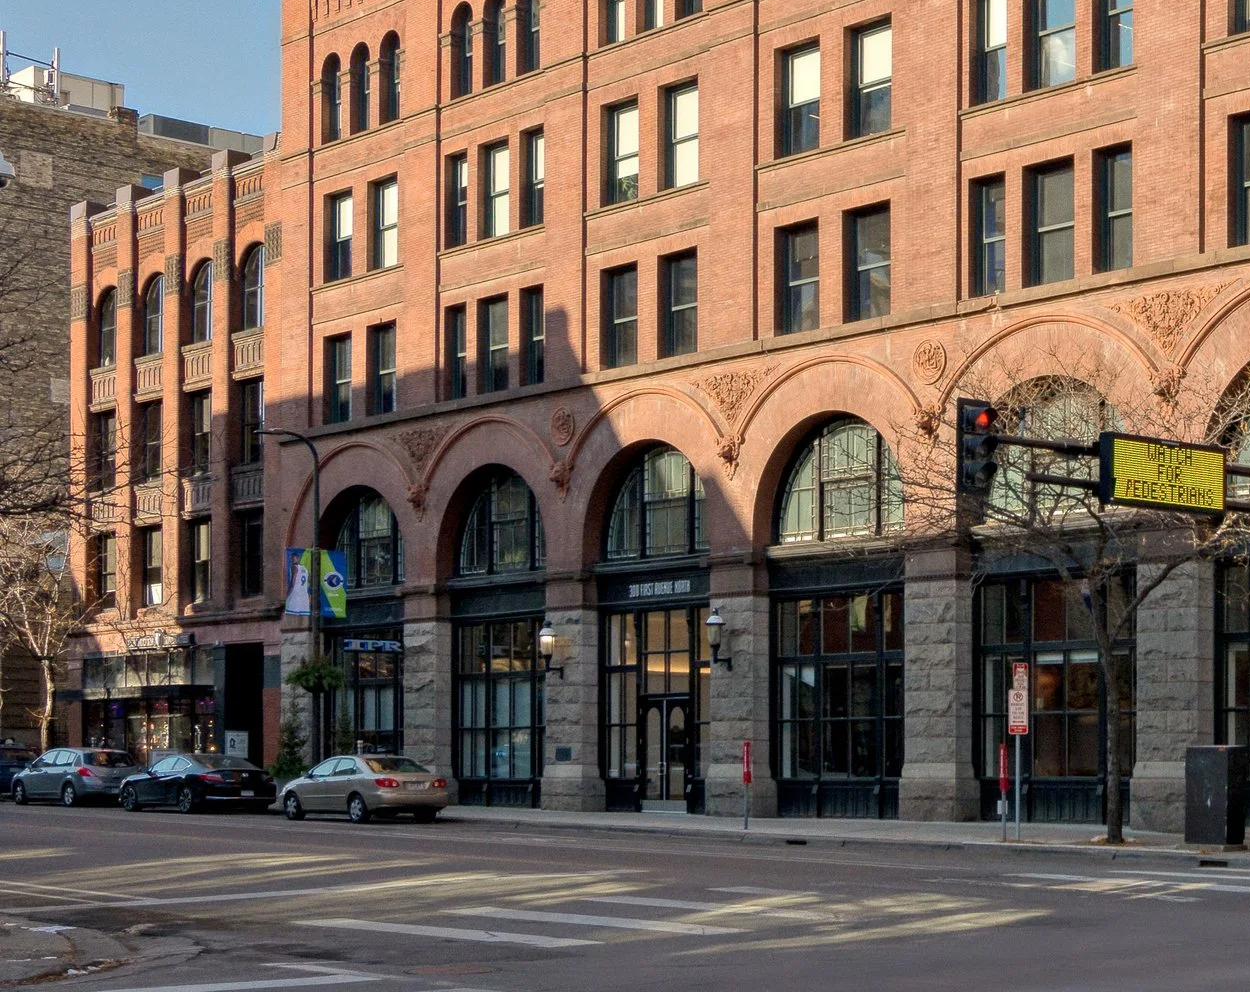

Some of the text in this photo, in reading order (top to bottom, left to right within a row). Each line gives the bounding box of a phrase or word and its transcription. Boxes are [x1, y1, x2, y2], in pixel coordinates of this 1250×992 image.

[1148, 443, 1193, 466] WATCH
[1158, 464, 1182, 484] FOR
[1125, 479, 1214, 506] PEDESTRIANS
